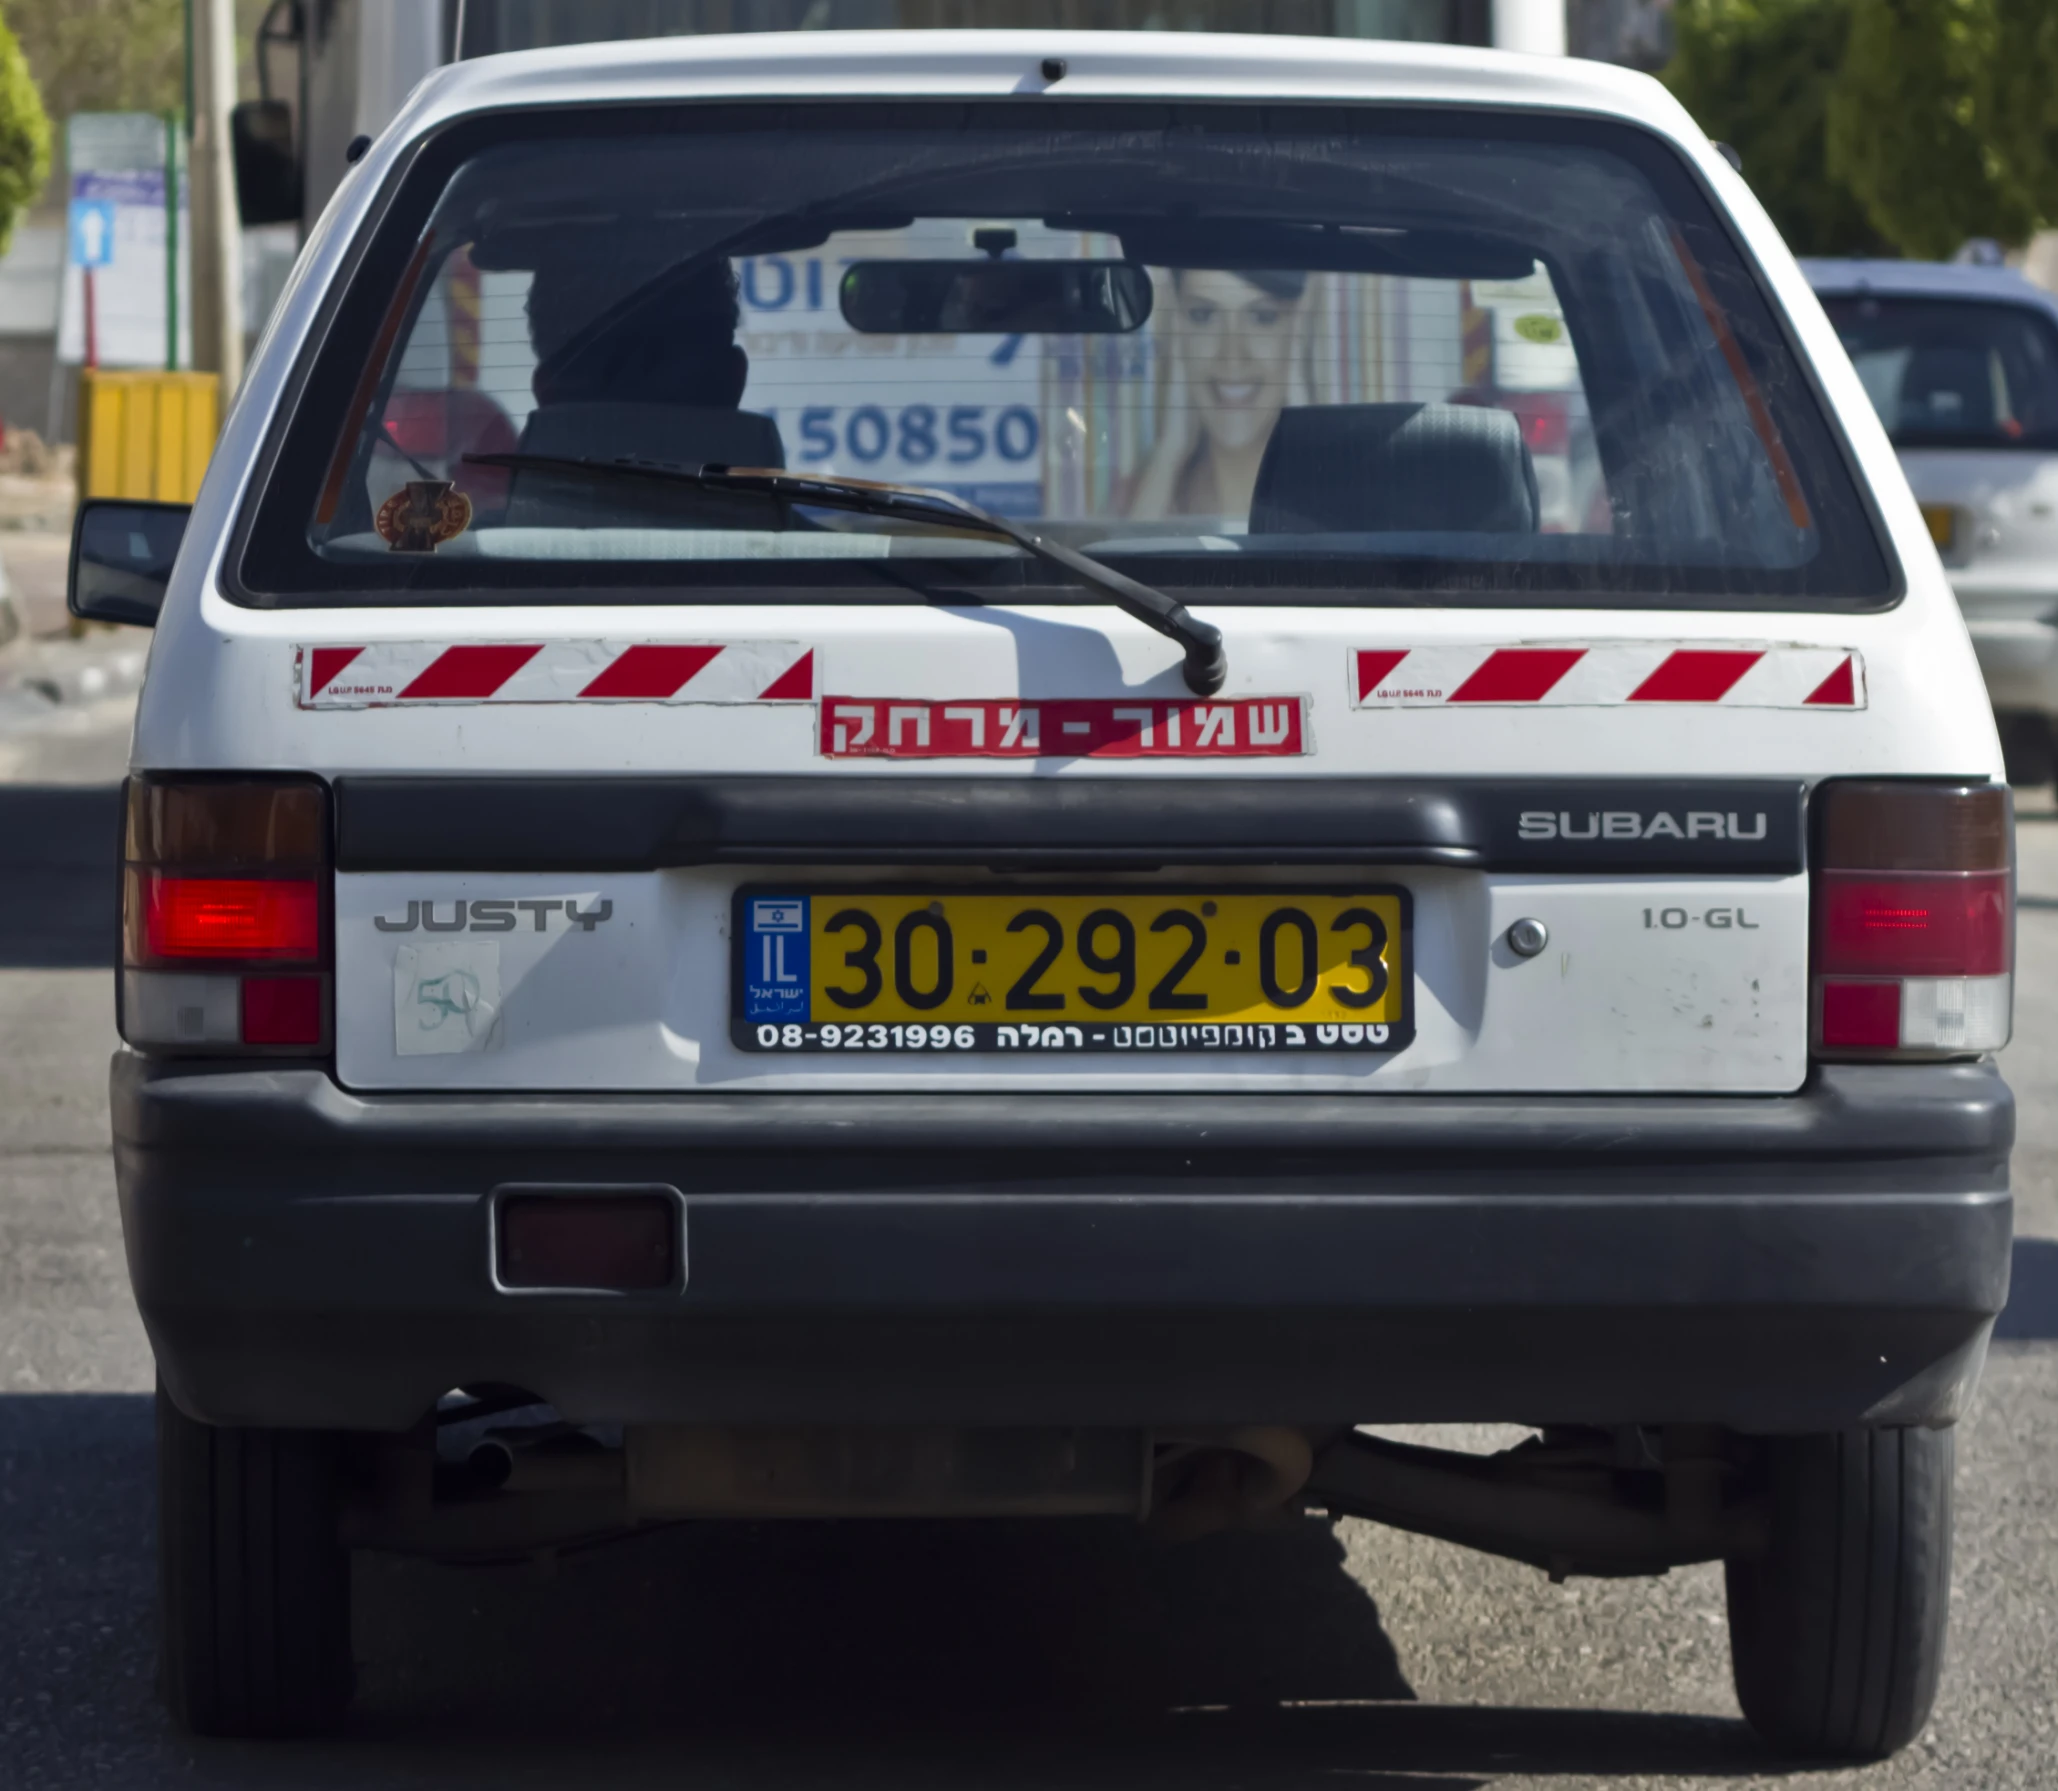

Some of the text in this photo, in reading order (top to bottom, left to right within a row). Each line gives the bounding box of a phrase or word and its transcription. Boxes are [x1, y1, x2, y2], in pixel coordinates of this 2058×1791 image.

[833, 705, 1041, 752] מרחק
[1112, 703, 1289, 747] שמור
[1518, 811, 1767, 840] SUBARU
[374, 899, 613, 932] JUSTY
[763, 935, 797, 982] IL
[749, 984, 804, 999] ישראל
[757, 1023, 976, 1048] 08-9231996
[997, 1024, 1083, 1047] רמלה
[1316, 1024, 1389, 1045] טסט
